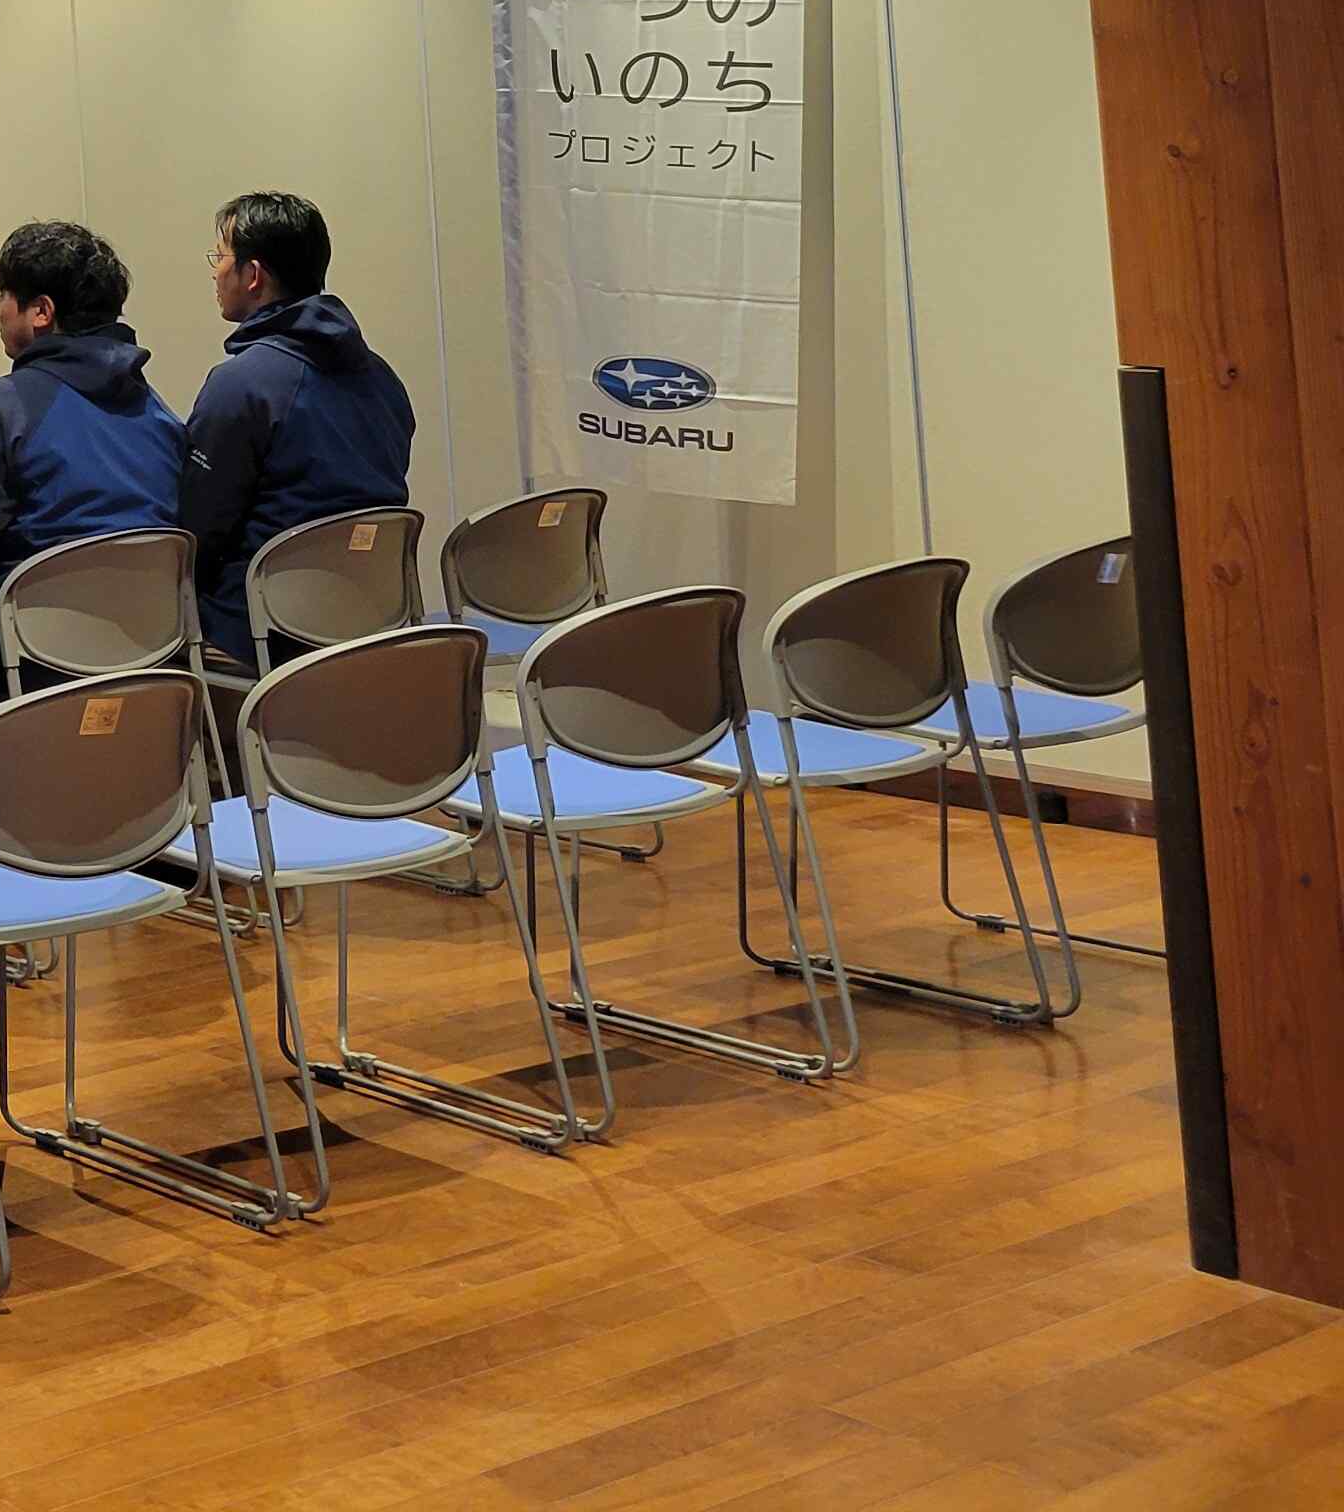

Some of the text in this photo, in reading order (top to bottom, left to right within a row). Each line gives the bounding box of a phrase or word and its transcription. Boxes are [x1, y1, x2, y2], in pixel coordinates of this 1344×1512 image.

[549, 47, 775, 114] いのち
[547, 127, 777, 173] プロジェクト
[577, 411, 735, 453] SUBARU
